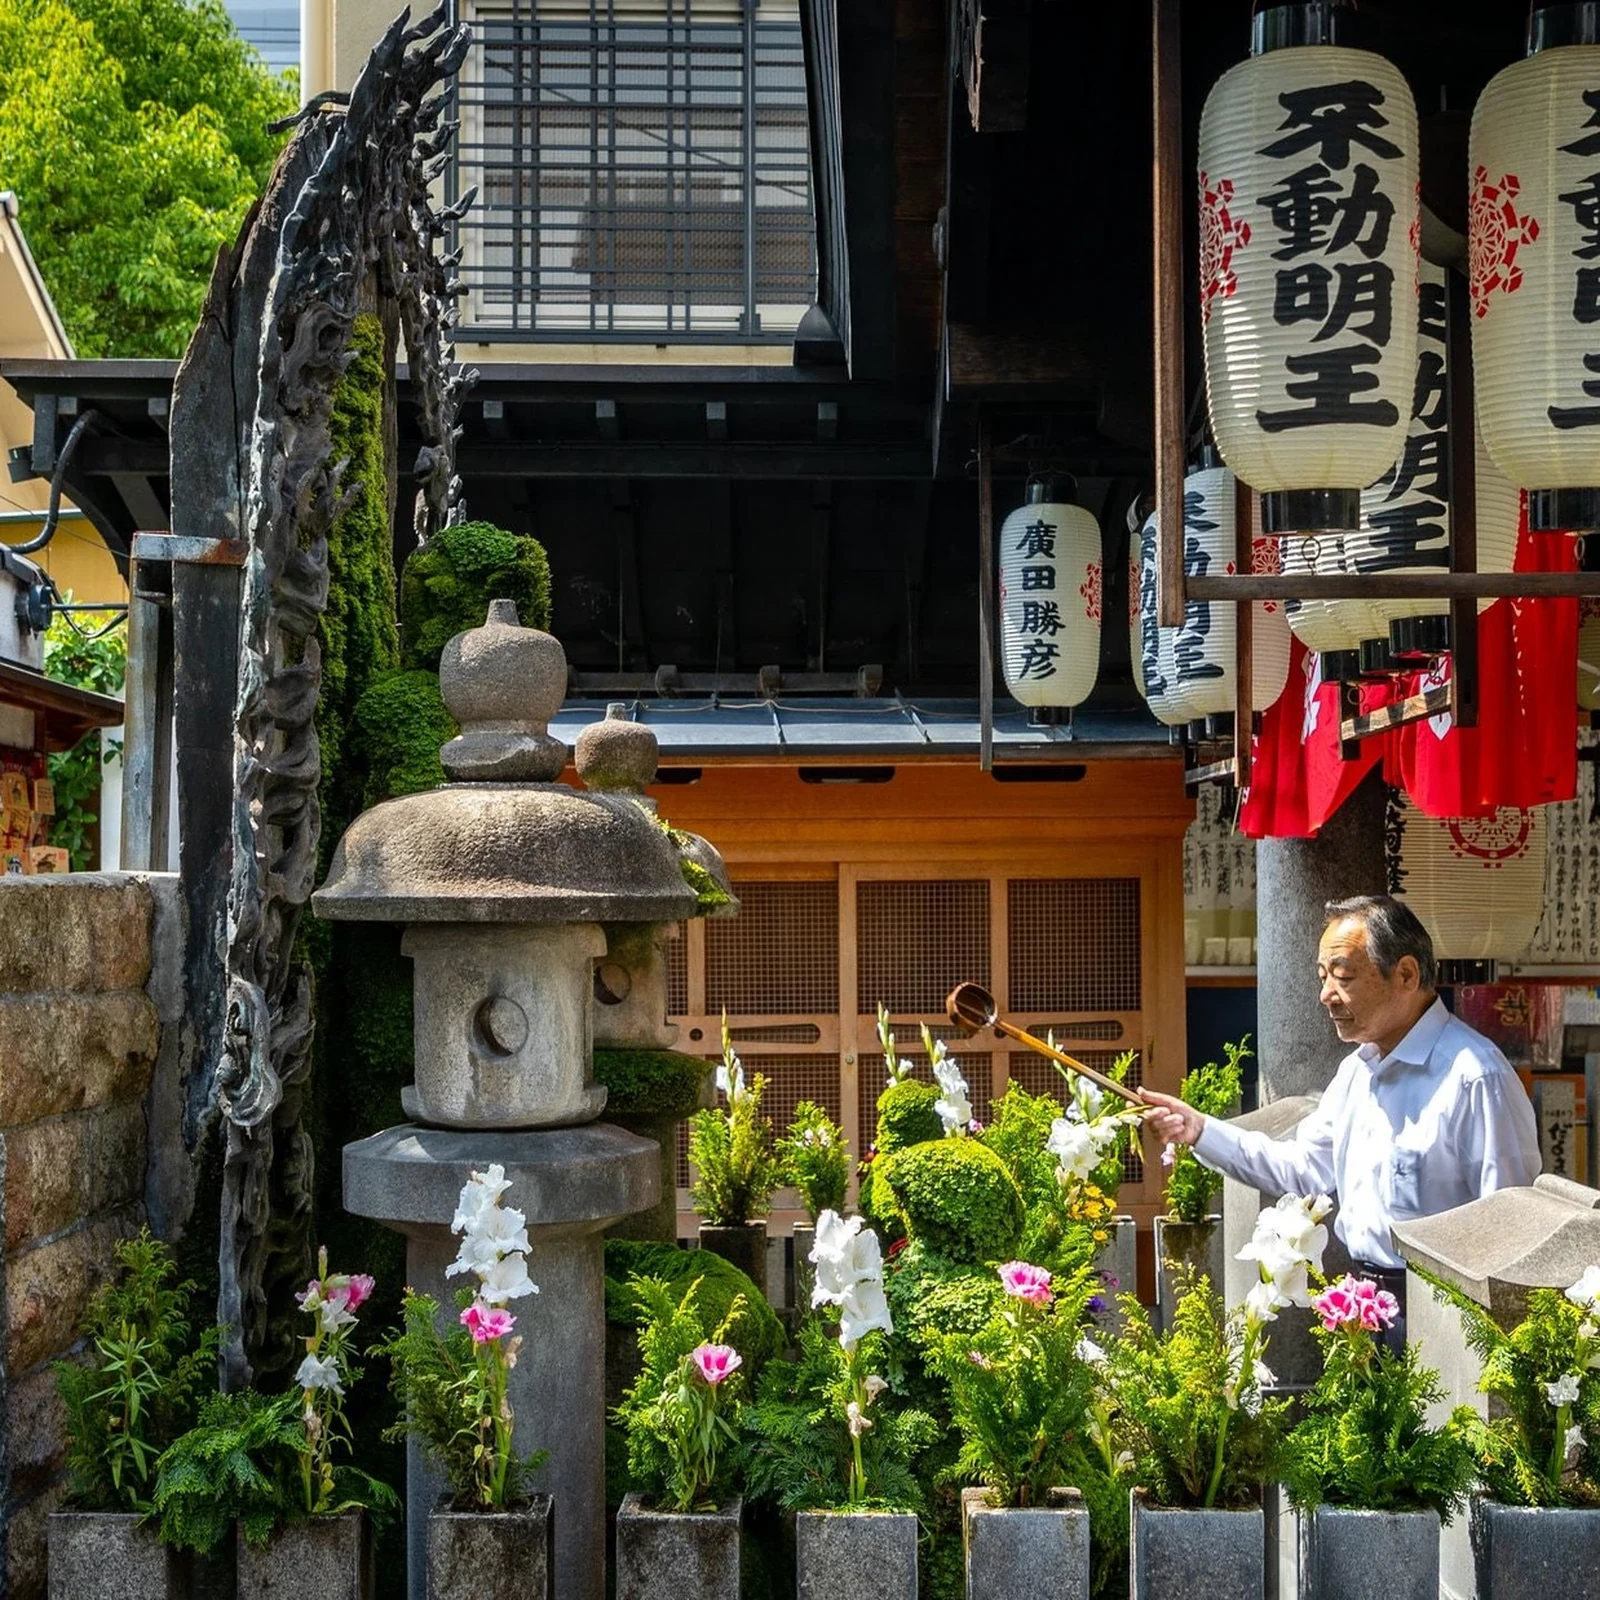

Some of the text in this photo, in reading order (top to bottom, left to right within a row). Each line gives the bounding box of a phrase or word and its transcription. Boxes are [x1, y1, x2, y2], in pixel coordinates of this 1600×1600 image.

[1256, 80, 1404, 432] 不動明王
[1016, 519, 1066, 681] 廣田勝彦
